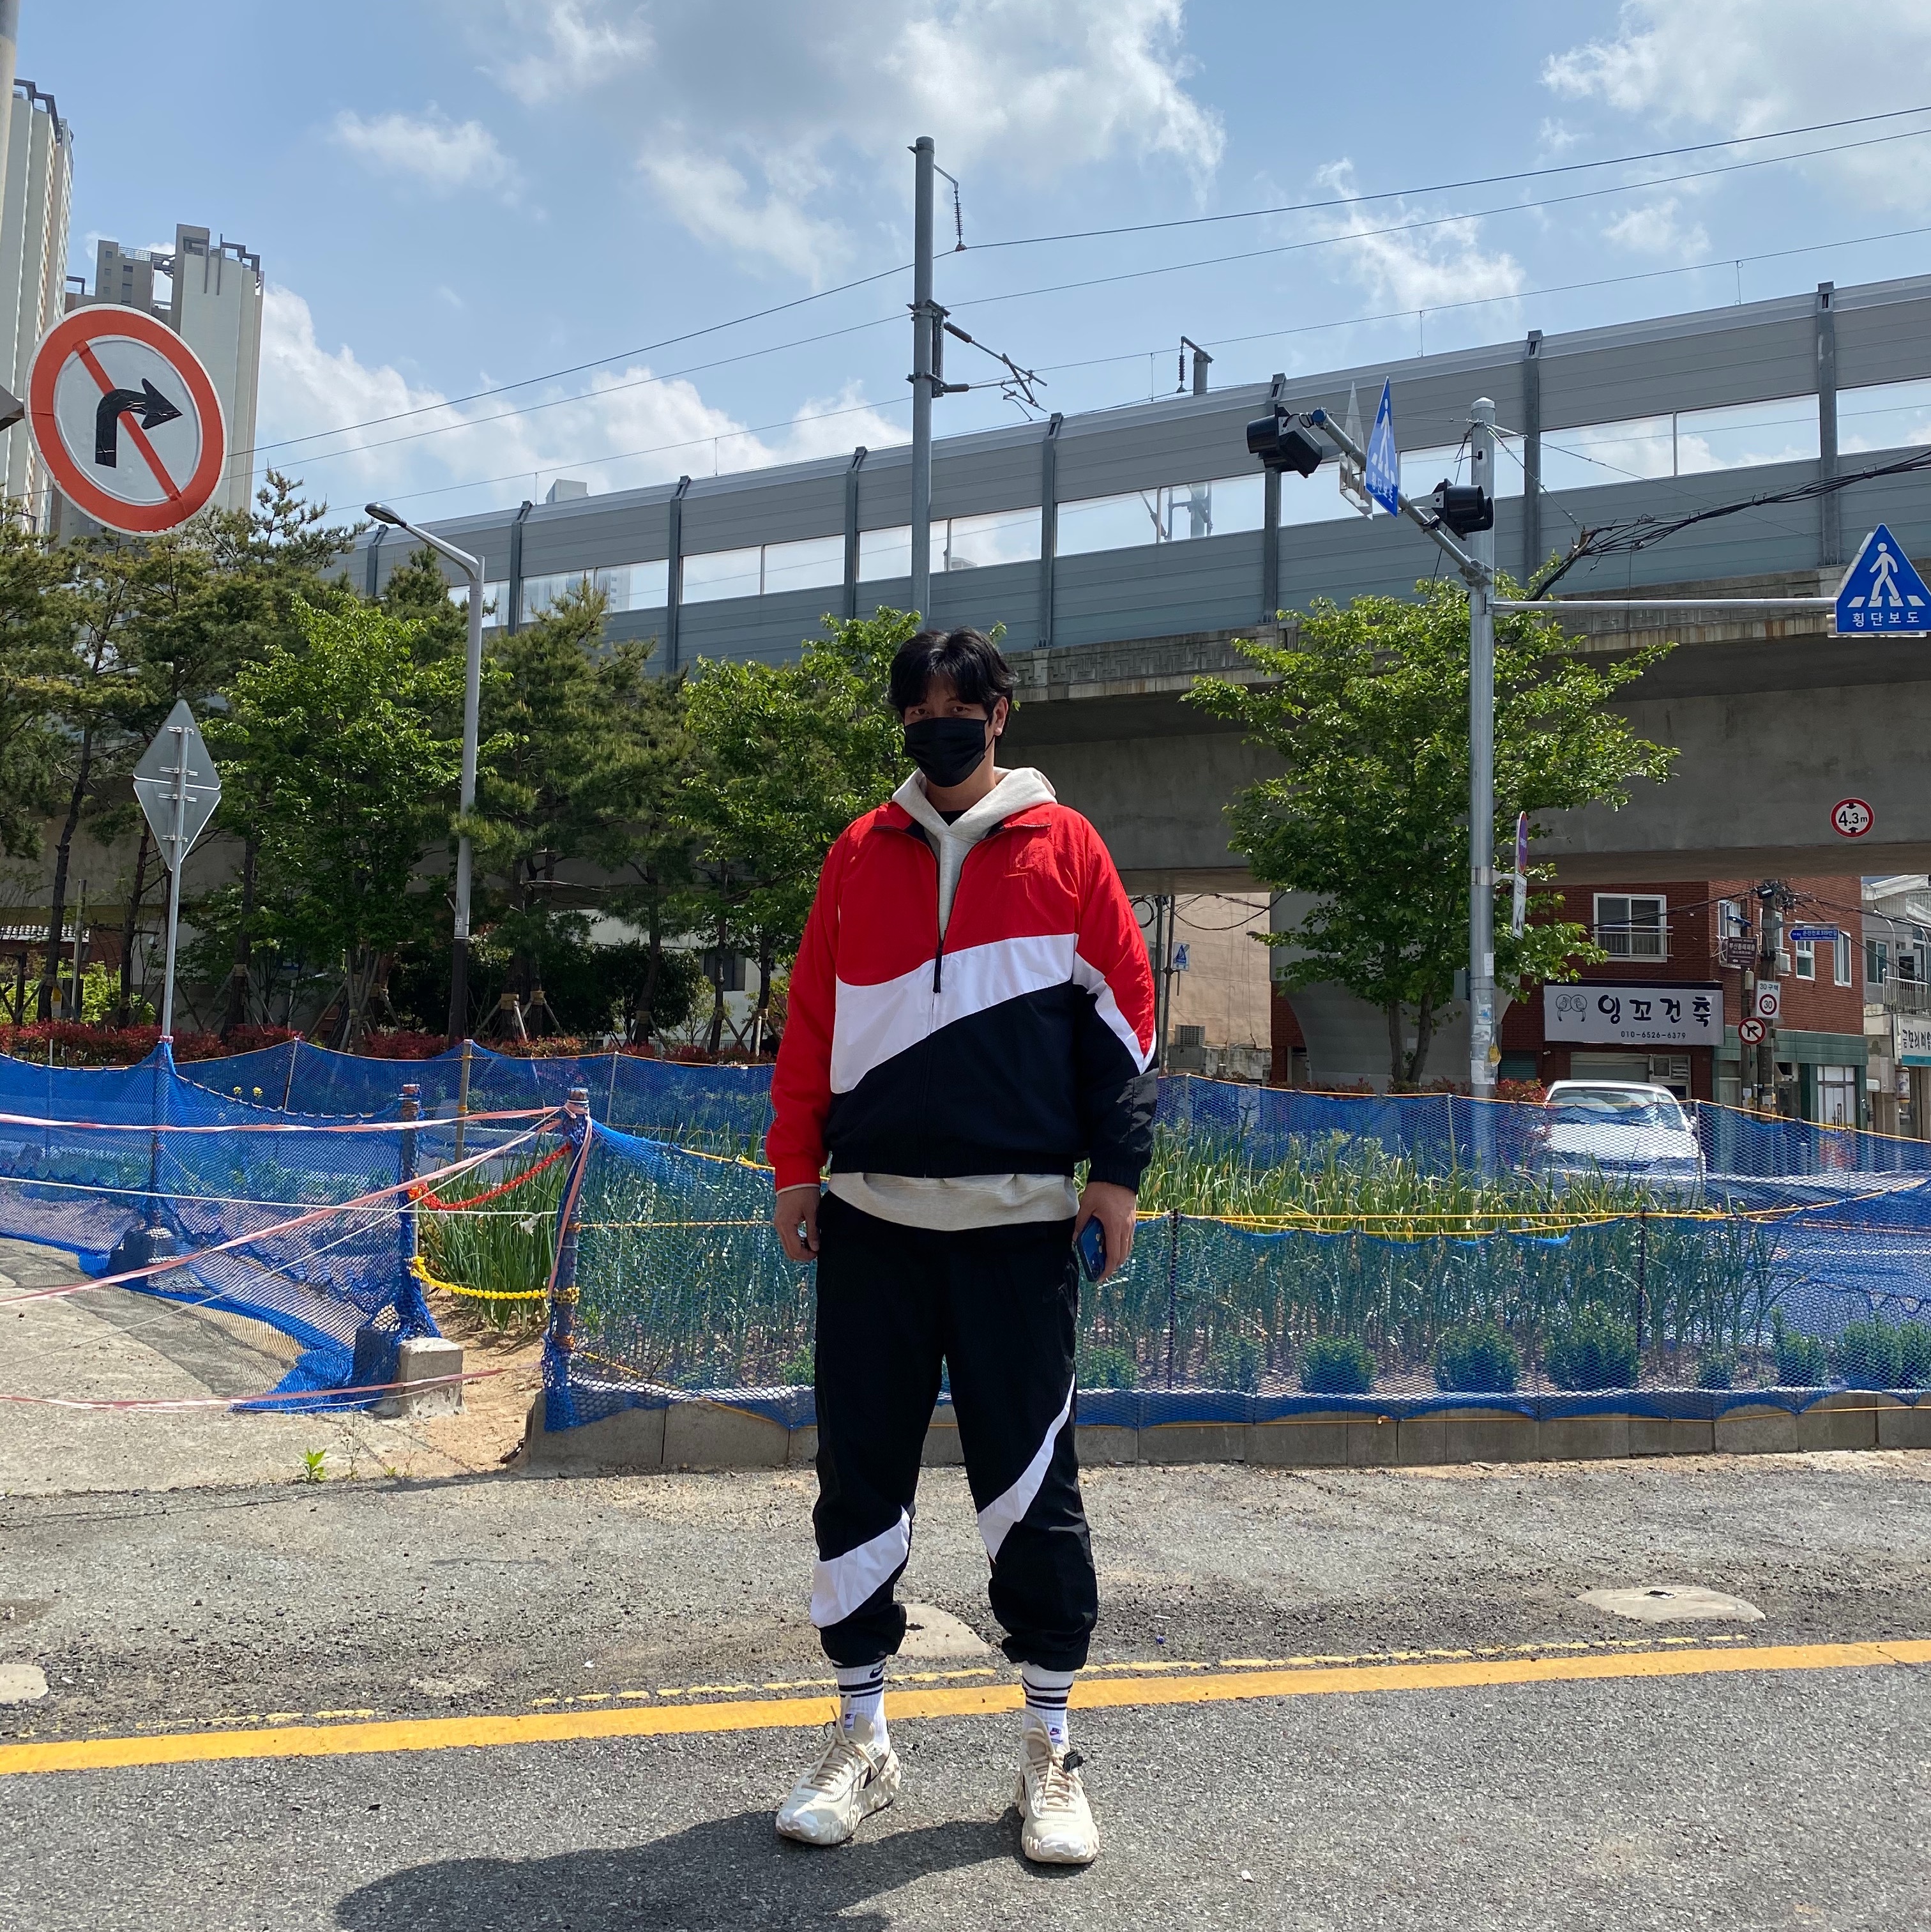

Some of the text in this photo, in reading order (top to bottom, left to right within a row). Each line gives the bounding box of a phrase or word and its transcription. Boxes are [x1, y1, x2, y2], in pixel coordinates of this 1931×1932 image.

[1852, 611, 1920, 627] 횡단보도
[1598, 994, 1711, 1027] 잉꼬건축
[1764, 1000, 1773, 1009] 30
[1621, 1030, 1686, 1039] 010-6526-6379
